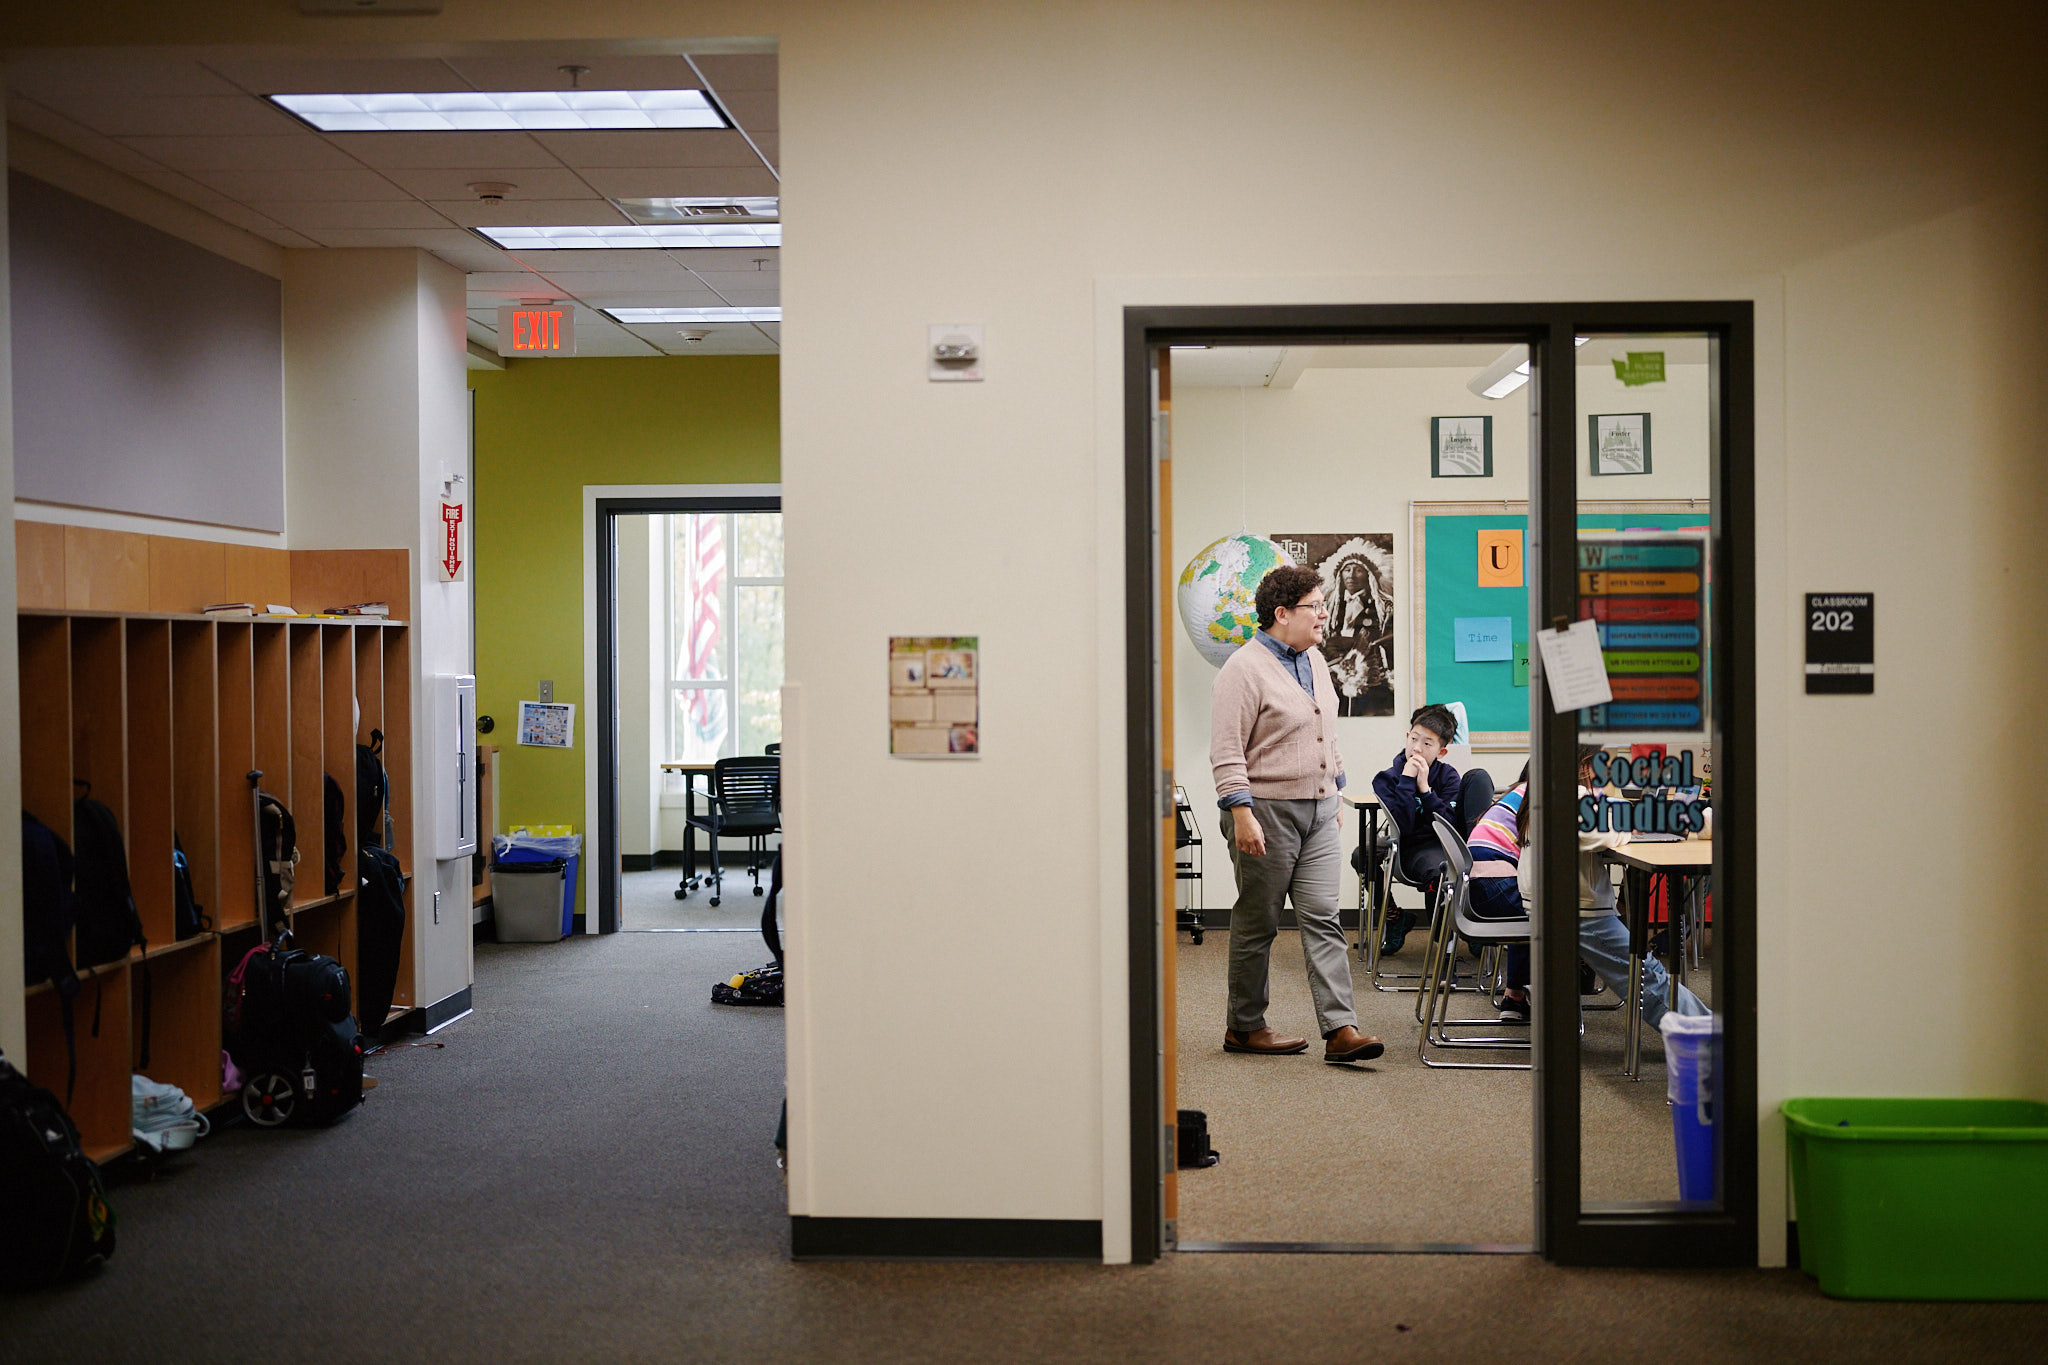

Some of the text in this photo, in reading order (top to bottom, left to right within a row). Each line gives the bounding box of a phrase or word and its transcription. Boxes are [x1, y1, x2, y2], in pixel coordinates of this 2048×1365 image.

[512, 311, 563, 350] EXIT
[1450, 436, 1473, 444] Inspire
[445, 508, 460, 520] FIRE
[1281, 538, 1308, 554] TEN
[1489, 544, 1510, 570] U
[1811, 597, 1868, 607] CLASSROOM
[1811, 611, 1854, 631] 202
[1468, 632, 1499, 643] Time
[1592, 749, 1694, 788] Social
[1578, 794, 1705, 833] Studies
